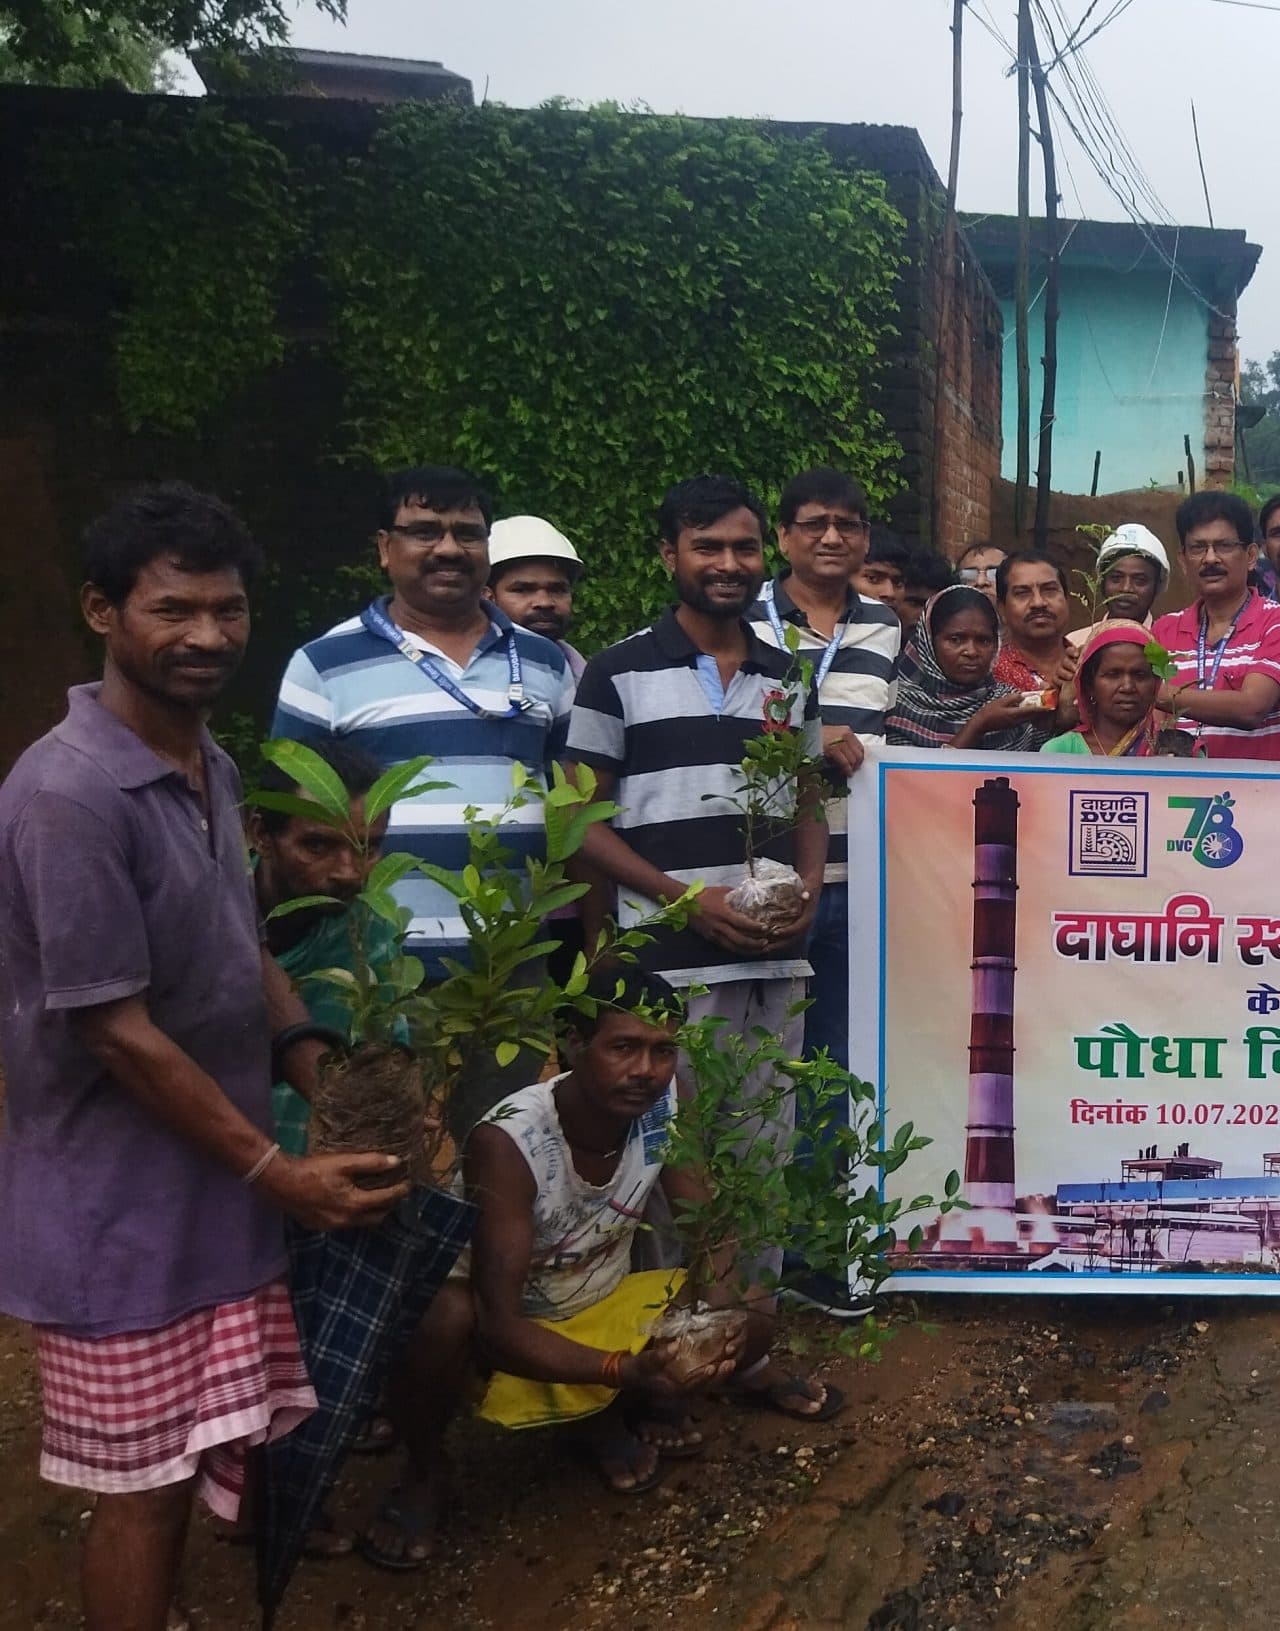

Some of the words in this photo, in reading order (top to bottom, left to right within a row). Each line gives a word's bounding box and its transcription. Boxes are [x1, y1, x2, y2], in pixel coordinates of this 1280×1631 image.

[1081, 796, 1137, 811] दाघानि
[1081, 812, 1138, 823] DVC
[1166, 839, 1193, 852] DVC
[1054, 894, 1225, 963] दाघानि
[1074, 1023, 1227, 1079] पौधा
[1071, 1099, 1148, 1125] दिनांक
